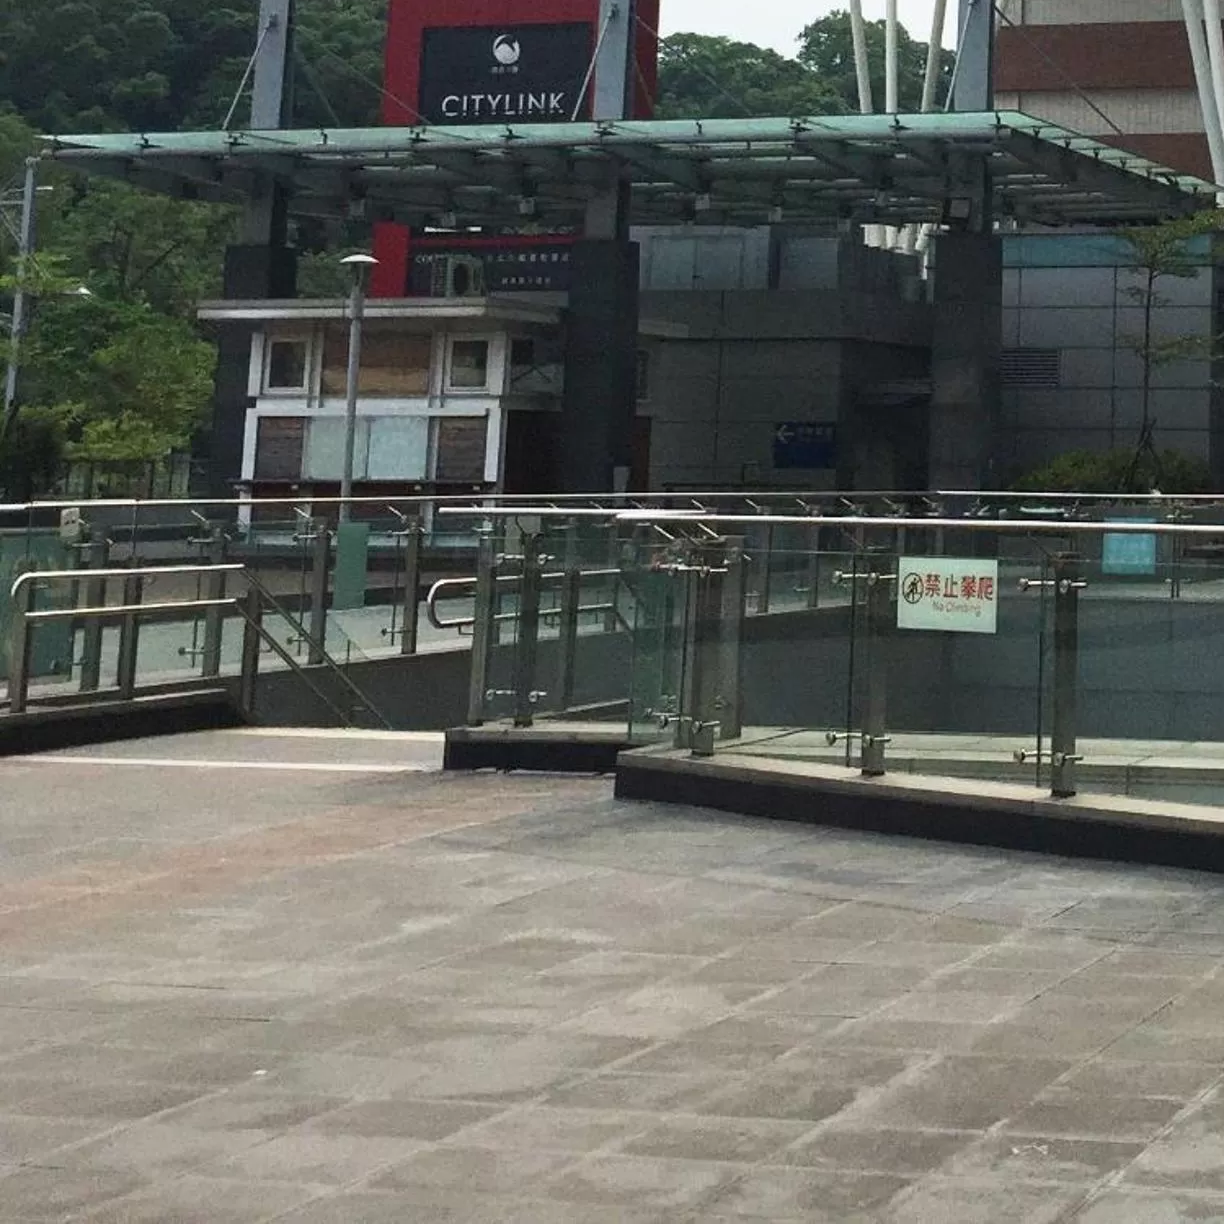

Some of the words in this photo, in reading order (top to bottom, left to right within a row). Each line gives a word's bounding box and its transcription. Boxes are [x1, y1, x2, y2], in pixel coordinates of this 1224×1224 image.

[441, 92, 565, 117] CITYLINK
[925, 573, 993, 602] 禁止攀爬
